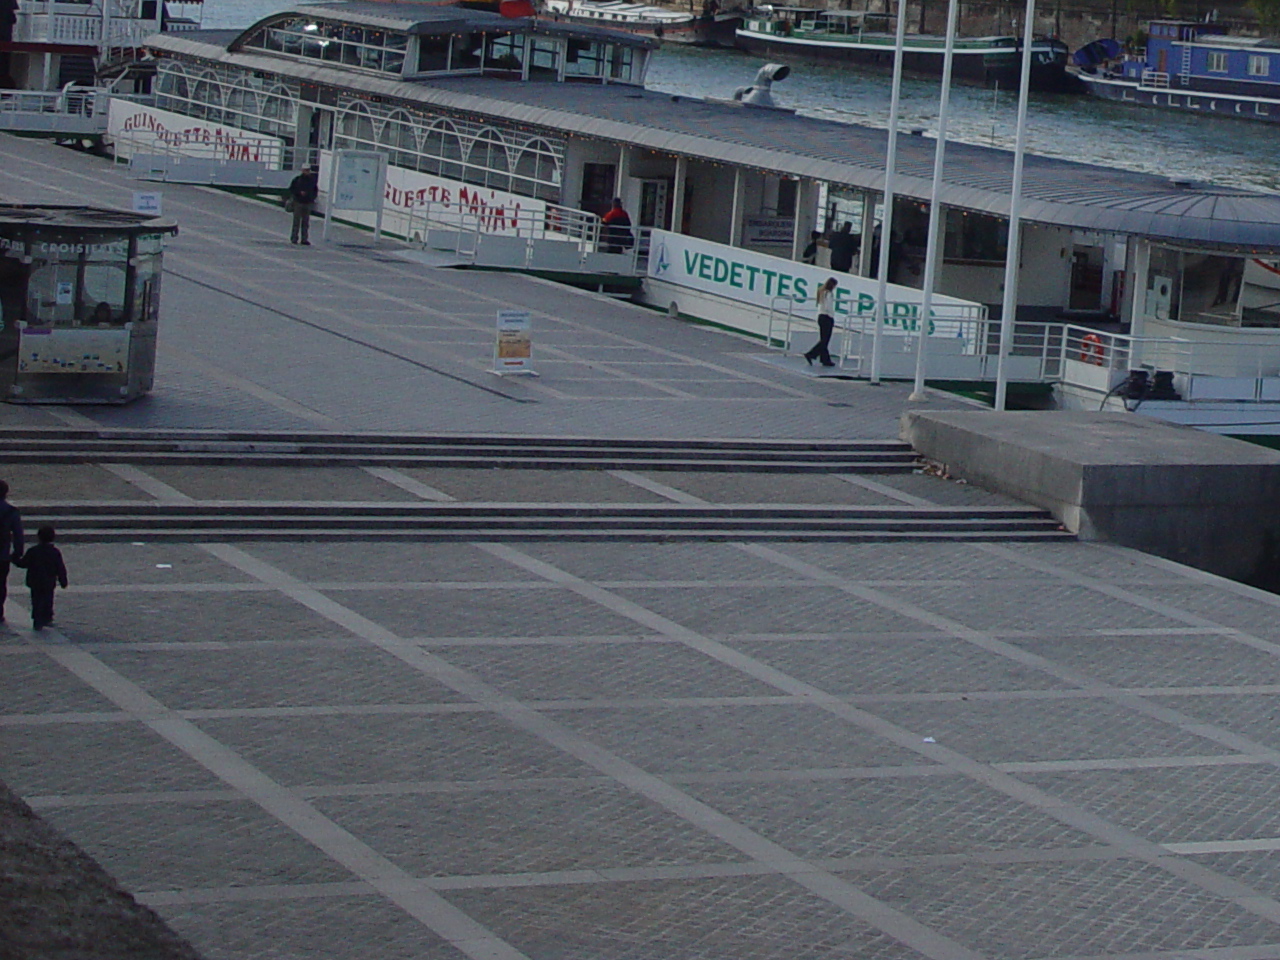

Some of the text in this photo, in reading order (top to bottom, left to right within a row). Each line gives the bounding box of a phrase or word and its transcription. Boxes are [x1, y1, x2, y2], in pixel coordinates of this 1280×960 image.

[124, 112, 211, 147] GUINGUETTE
[683, 248, 808, 304] VEDETTES
[816, 283, 852, 316] E
